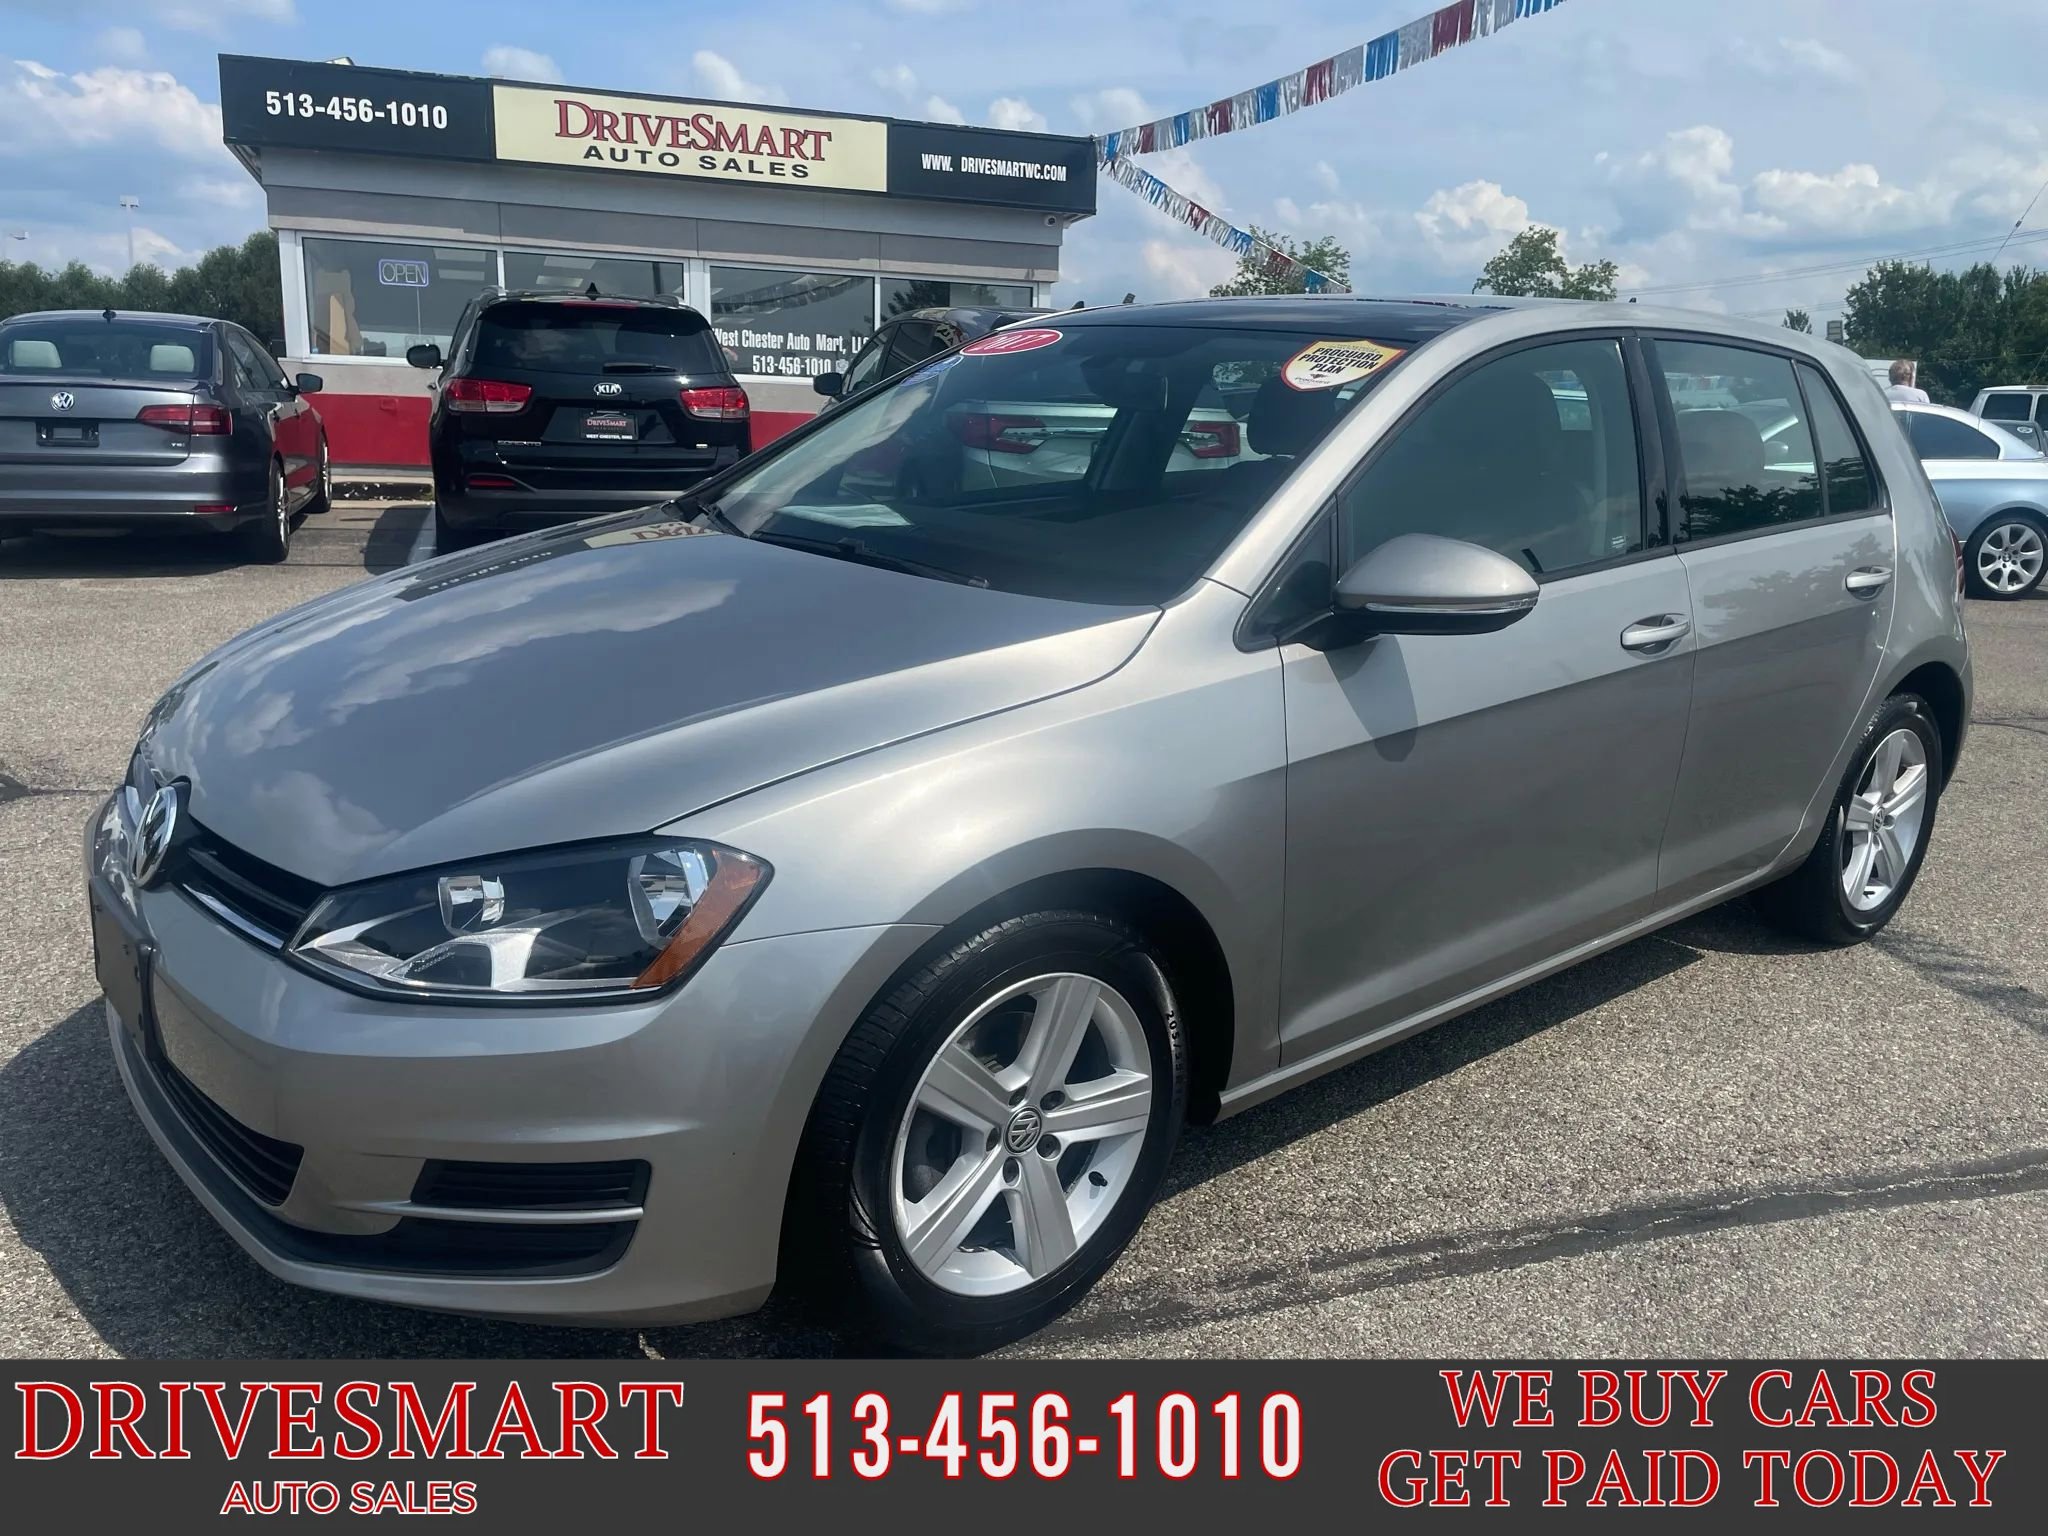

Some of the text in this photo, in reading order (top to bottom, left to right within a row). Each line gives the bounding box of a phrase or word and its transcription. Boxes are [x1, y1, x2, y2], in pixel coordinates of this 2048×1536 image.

[266, 91, 448, 129] 513-456-1010
[583, 145, 809, 178] AUTO SALES
[921, 153, 1067, 182] WWW. DRIVESMARTWC.COM
[382, 262, 426, 284] OPEN
[712, 328, 739, 348] West
[741, 329, 784, 350] Chester
[786, 332, 810, 351] Auto
[816, 333, 847, 355] Mart,
[752, 354, 832, 375] 513-456-1010
[1298, 353, 1379, 370] PROTECTION
[1312, 347, 1383, 362] PROGUARD
[1309, 363, 1346, 375] PLAN
[598, 384, 619, 394] KIA
